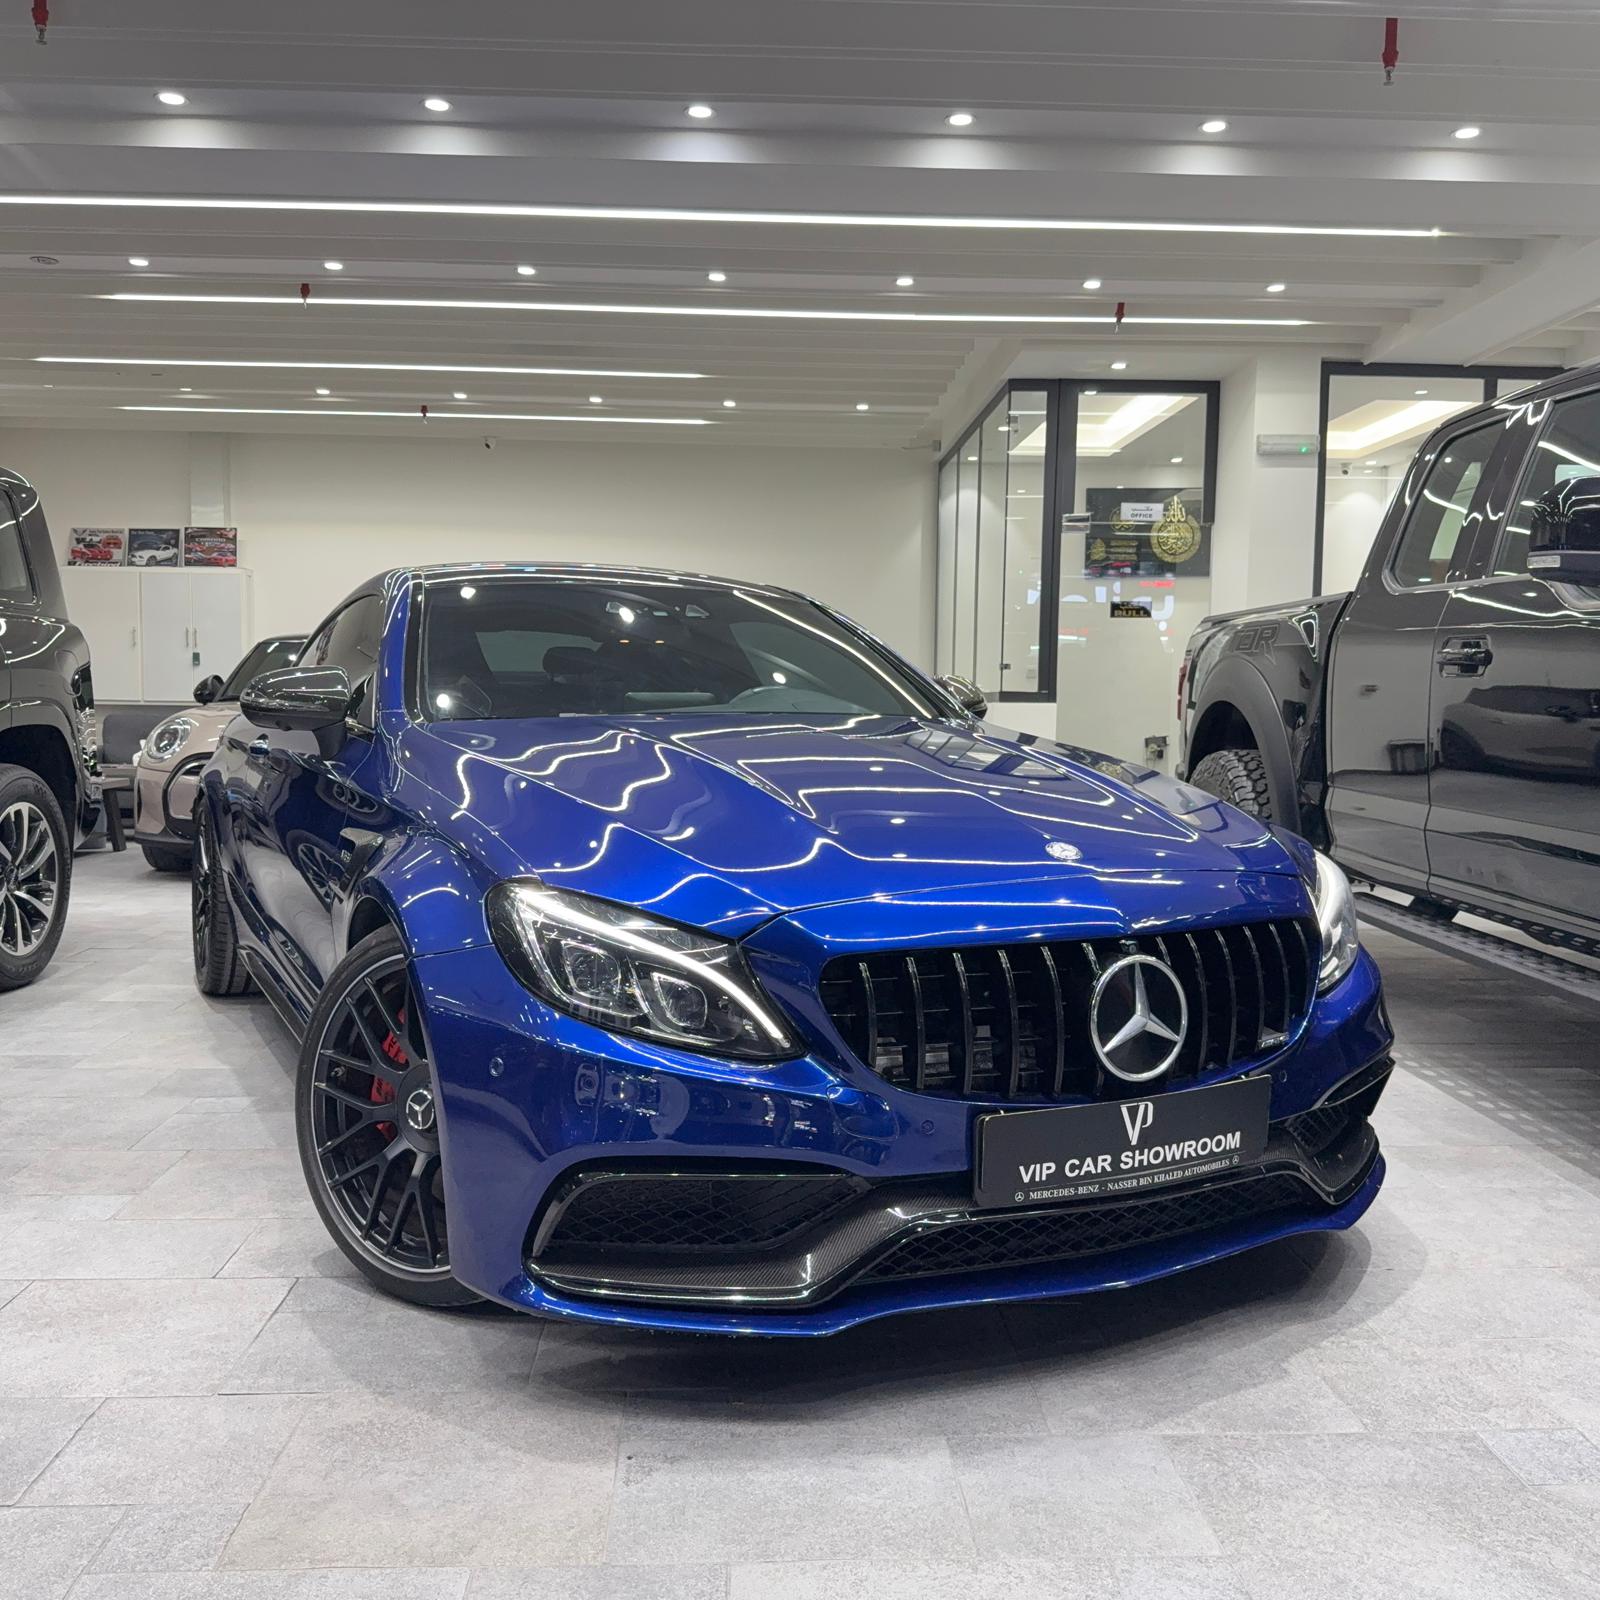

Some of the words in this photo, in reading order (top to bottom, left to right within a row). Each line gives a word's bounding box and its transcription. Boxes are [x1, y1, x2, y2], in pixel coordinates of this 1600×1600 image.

[1018, 1162, 1056, 1184] VIP
[1064, 1154, 1112, 1178] CAR
[1119, 1130, 1241, 1170] SHOWROOM
[1029, 1184, 1100, 1200] MERCEDES-BENZ
[1107, 1179, 1139, 1191] NASSER
[1139, 1175, 1153, 1187] BIN
[1153, 1169, 1183, 1184] KHALED
[1183, 1158, 1230, 1177] AUTOMOBILES
